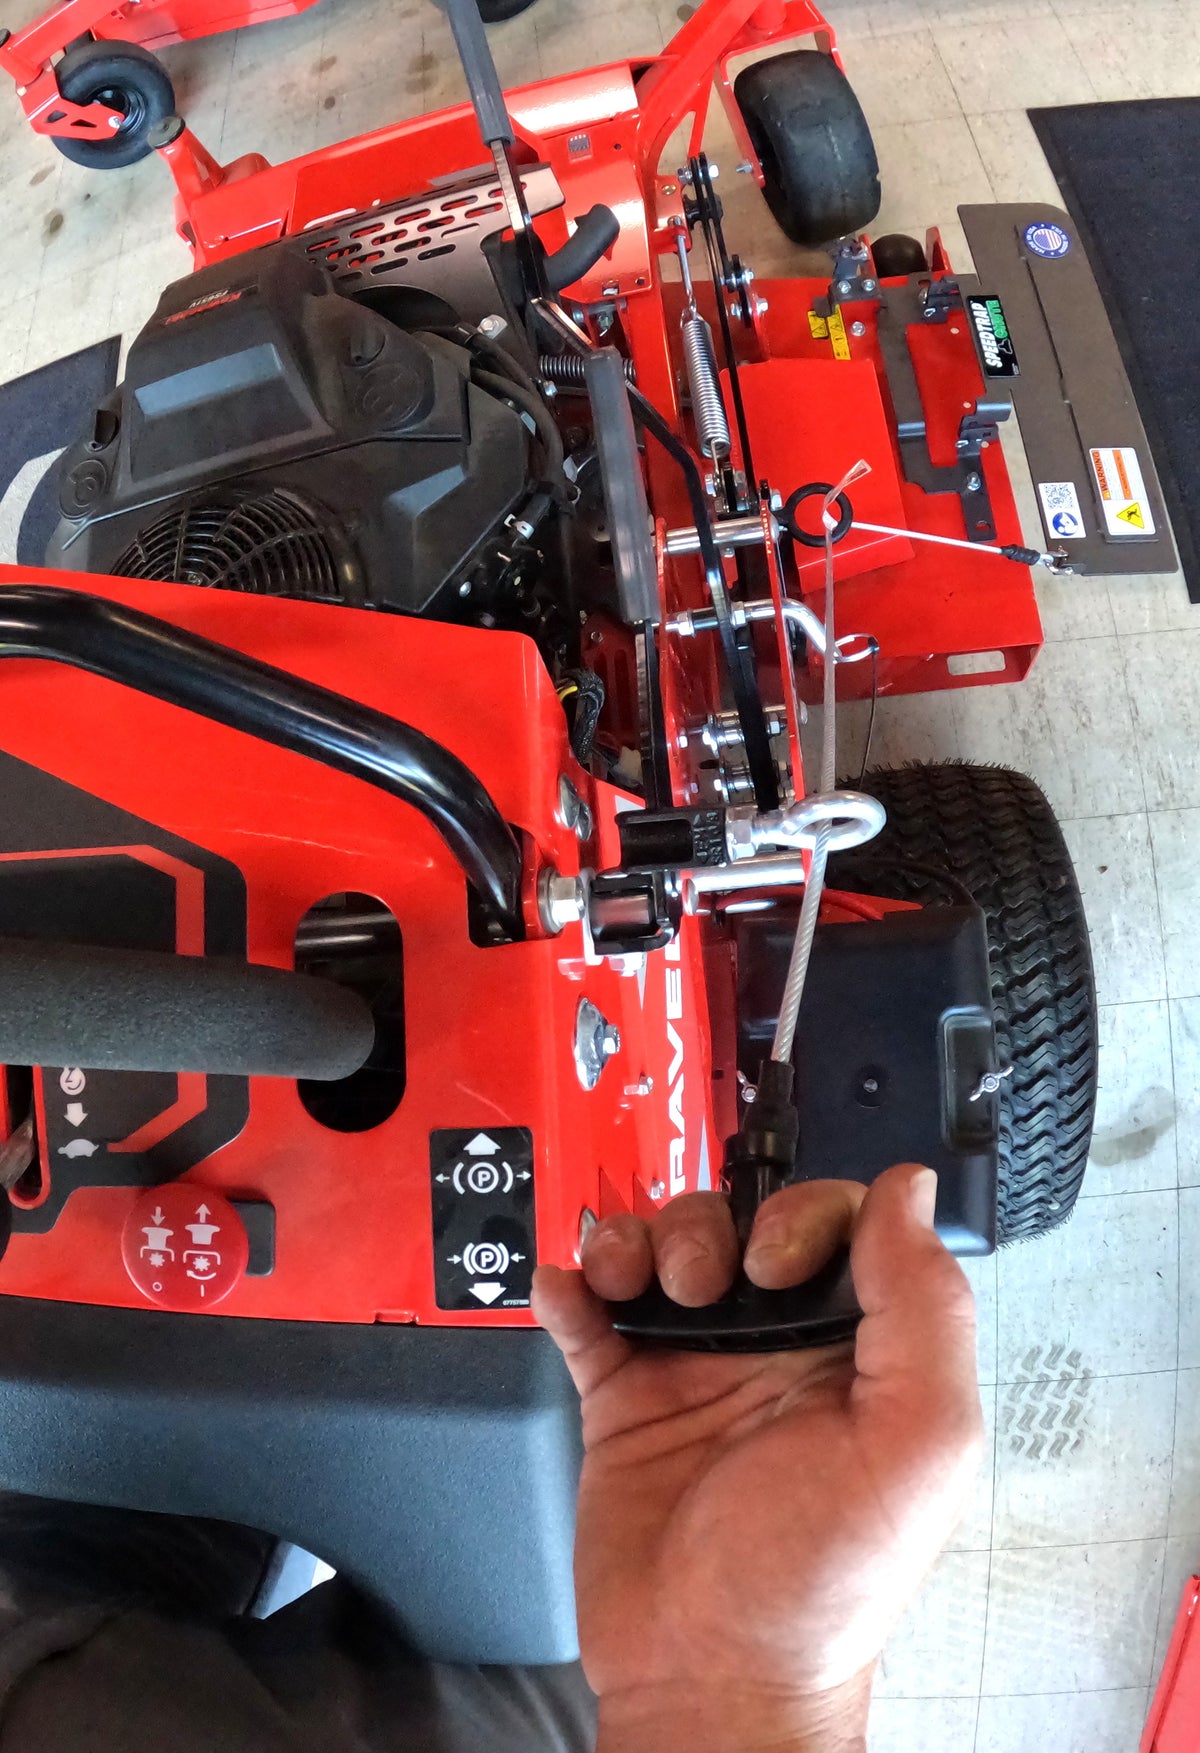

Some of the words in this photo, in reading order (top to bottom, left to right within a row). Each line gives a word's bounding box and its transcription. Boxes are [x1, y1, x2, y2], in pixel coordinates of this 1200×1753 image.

[970, 302, 1003, 368] SPEEDTRAP
[985, 299, 1009, 339] CHUTE
[1092, 451, 1109, 492] WARNING
[664, 931, 686, 1198] RAVEL
